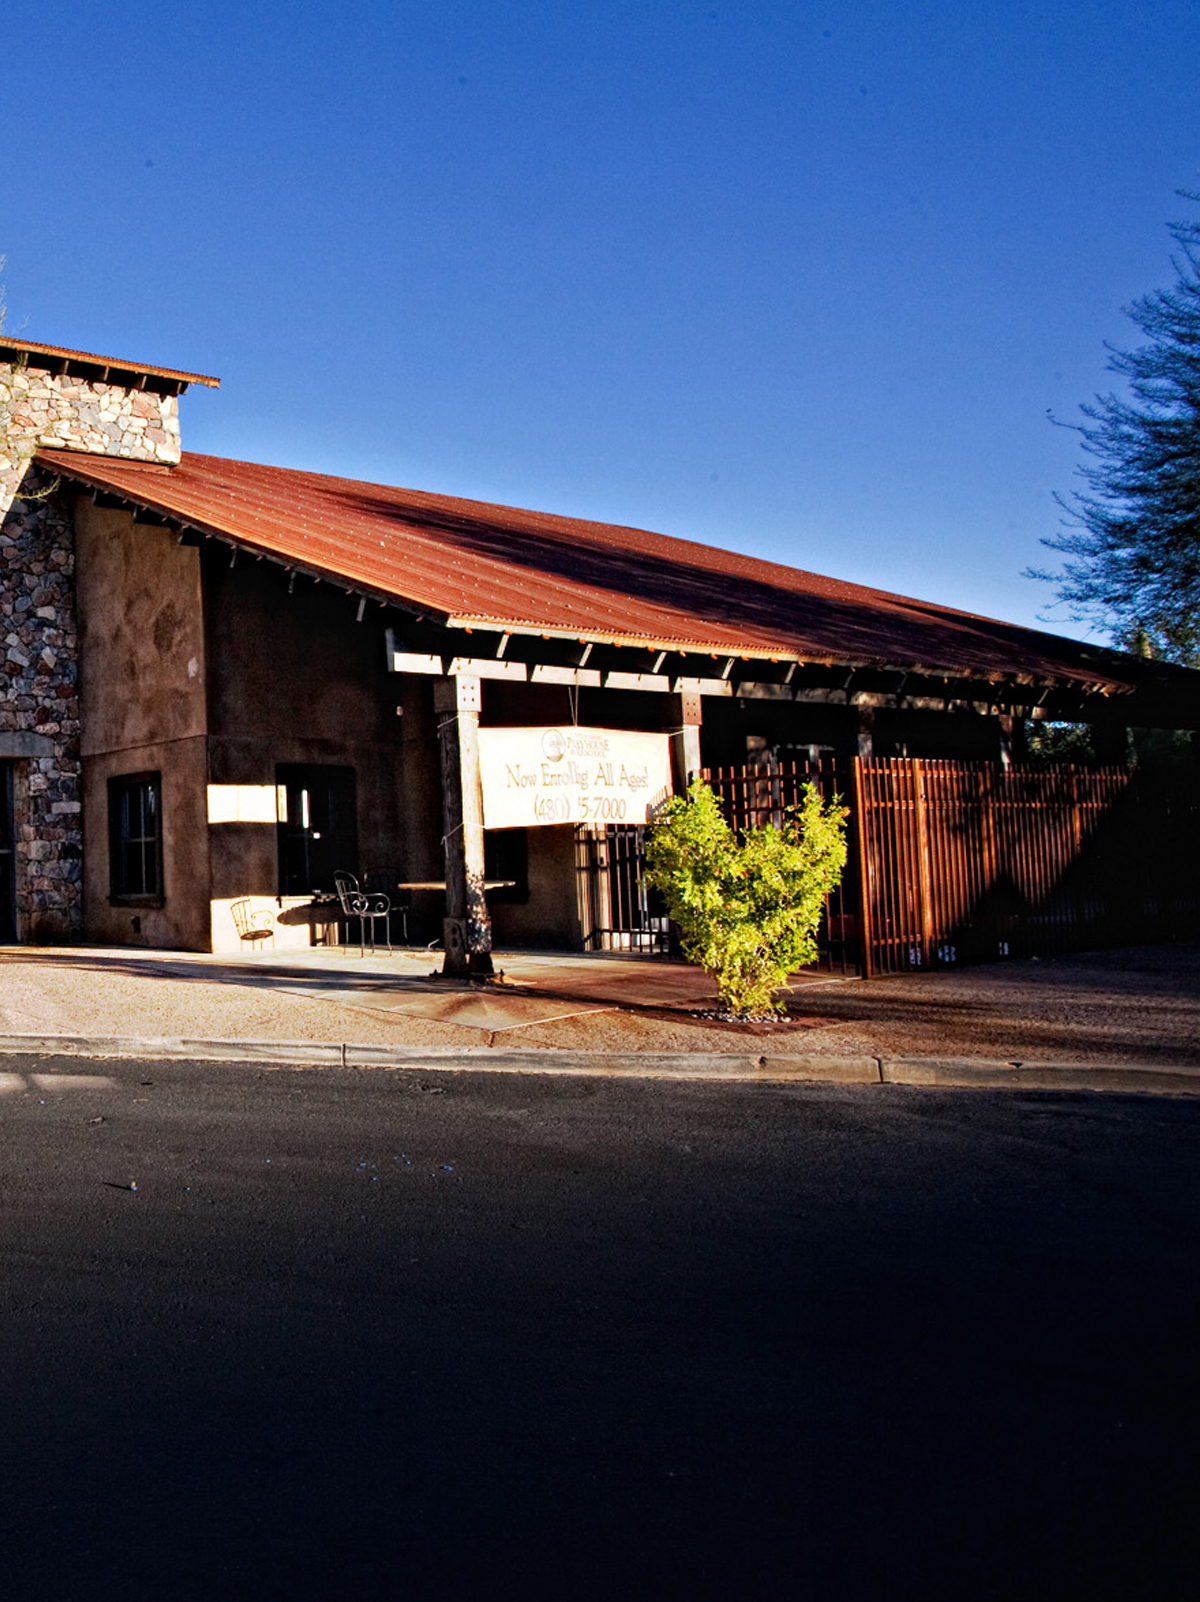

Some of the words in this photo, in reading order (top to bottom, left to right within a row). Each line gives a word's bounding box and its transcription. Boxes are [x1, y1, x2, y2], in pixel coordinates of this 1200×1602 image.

[505, 763, 537, 788] Now
[594, 762, 615, 787] All
[618, 763, 649, 792] Ages!
[534, 793, 571, 822] (480)
